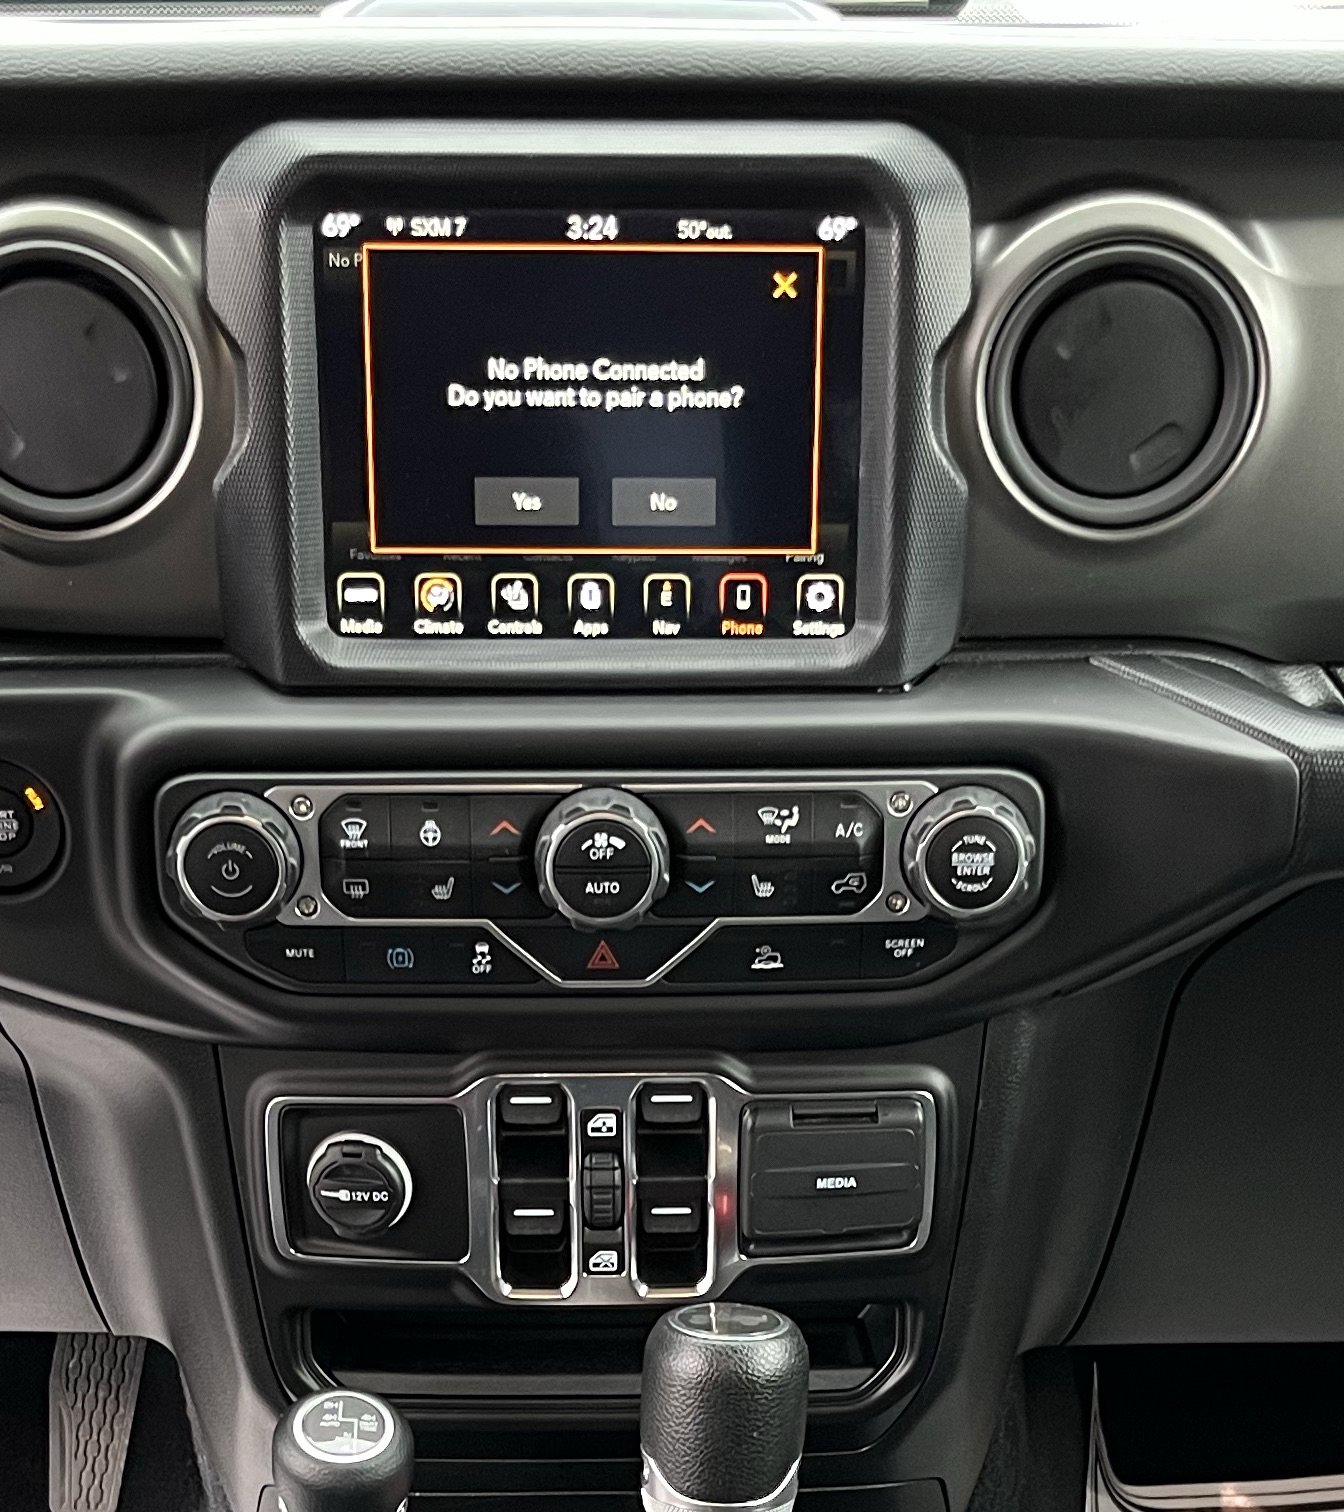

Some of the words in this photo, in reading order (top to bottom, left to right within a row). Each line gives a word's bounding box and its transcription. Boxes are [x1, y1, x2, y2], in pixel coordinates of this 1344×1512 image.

[410, 216, 451, 237] SXM
[454, 216, 467, 237] 7
[566, 214, 617, 240] 3:24
[329, 253, 350, 267] No
[487, 357, 519, 381] No
[523, 356, 589, 381] Phone
[592, 357, 706, 381] Connected
[448, 383, 480, 407] Do
[483, 389, 521, 411] you
[525, 387, 575, 408] want
[579, 387, 602, 407] to
[605, 386, 646, 412] pair
[649, 390, 663, 408] a
[667, 384, 744, 412] phone?
[512, 491, 542, 511] Yes
[650, 491, 678, 511] No
[340, 617, 383, 634] Media
[413, 618, 464, 634] Climate
[487, 619, 543, 635] Controls
[573, 619, 609, 637] Apps
[652, 620, 681, 635] Nav
[721, 620, 763, 635] Phone
[793, 620, 845, 638] Settings
[835, 821, 864, 838] A/C
[340, 839, 369, 849] FRONT
[765, 834, 791, 845] MODE
[962, 834, 987, 846] TUNE
[589, 846, 615, 861] OFF
[952, 852, 994, 866] BROWSE
[957, 865, 991, 876] ENTER
[585, 881, 620, 894] AUTO
[885, 938, 924, 949] SCREEN
[285, 948, 315, 958] MUTE
[894, 948, 913, 958] OFF
[472, 964, 493, 975] OFF
[816, 1177, 857, 1190] MEDIA
[351, 1191, 370, 1202] 12V
[373, 1191, 389, 1202] DC
